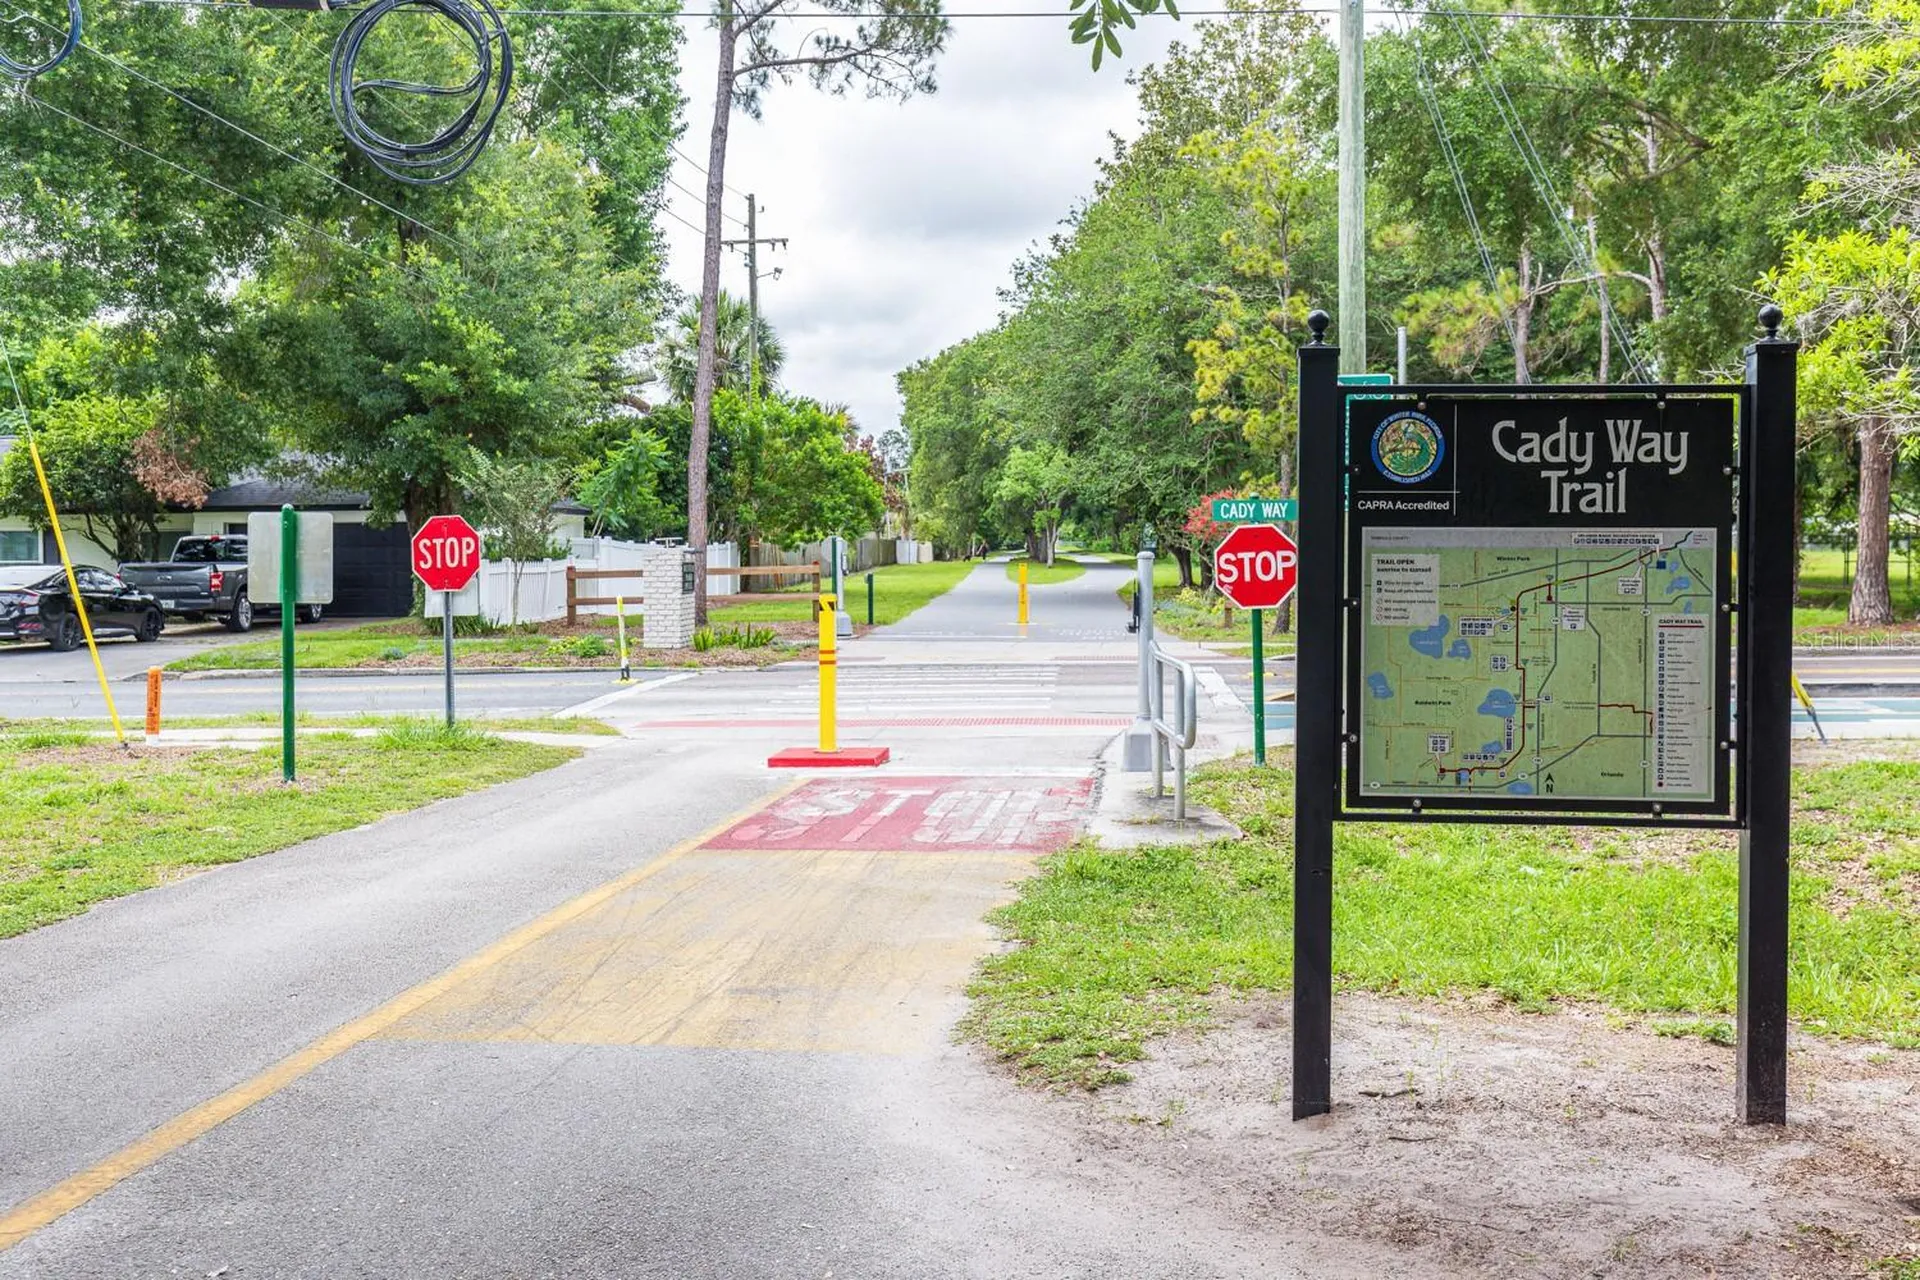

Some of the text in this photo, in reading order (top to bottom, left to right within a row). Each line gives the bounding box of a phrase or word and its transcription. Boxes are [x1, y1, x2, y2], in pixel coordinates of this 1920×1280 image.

[1492, 417, 1689, 475] Cady Way
[1358, 500, 1449, 510] CAPRA Accredited
[1541, 467, 1627, 513] Trail
[1221, 502, 1288, 519] CADY WAY
[419, 537, 476, 569] STOP
[1219, 550, 1297, 583] STOP
[1546, 784, 1554, 793] N
[730, 789, 1086, 844] STOP
